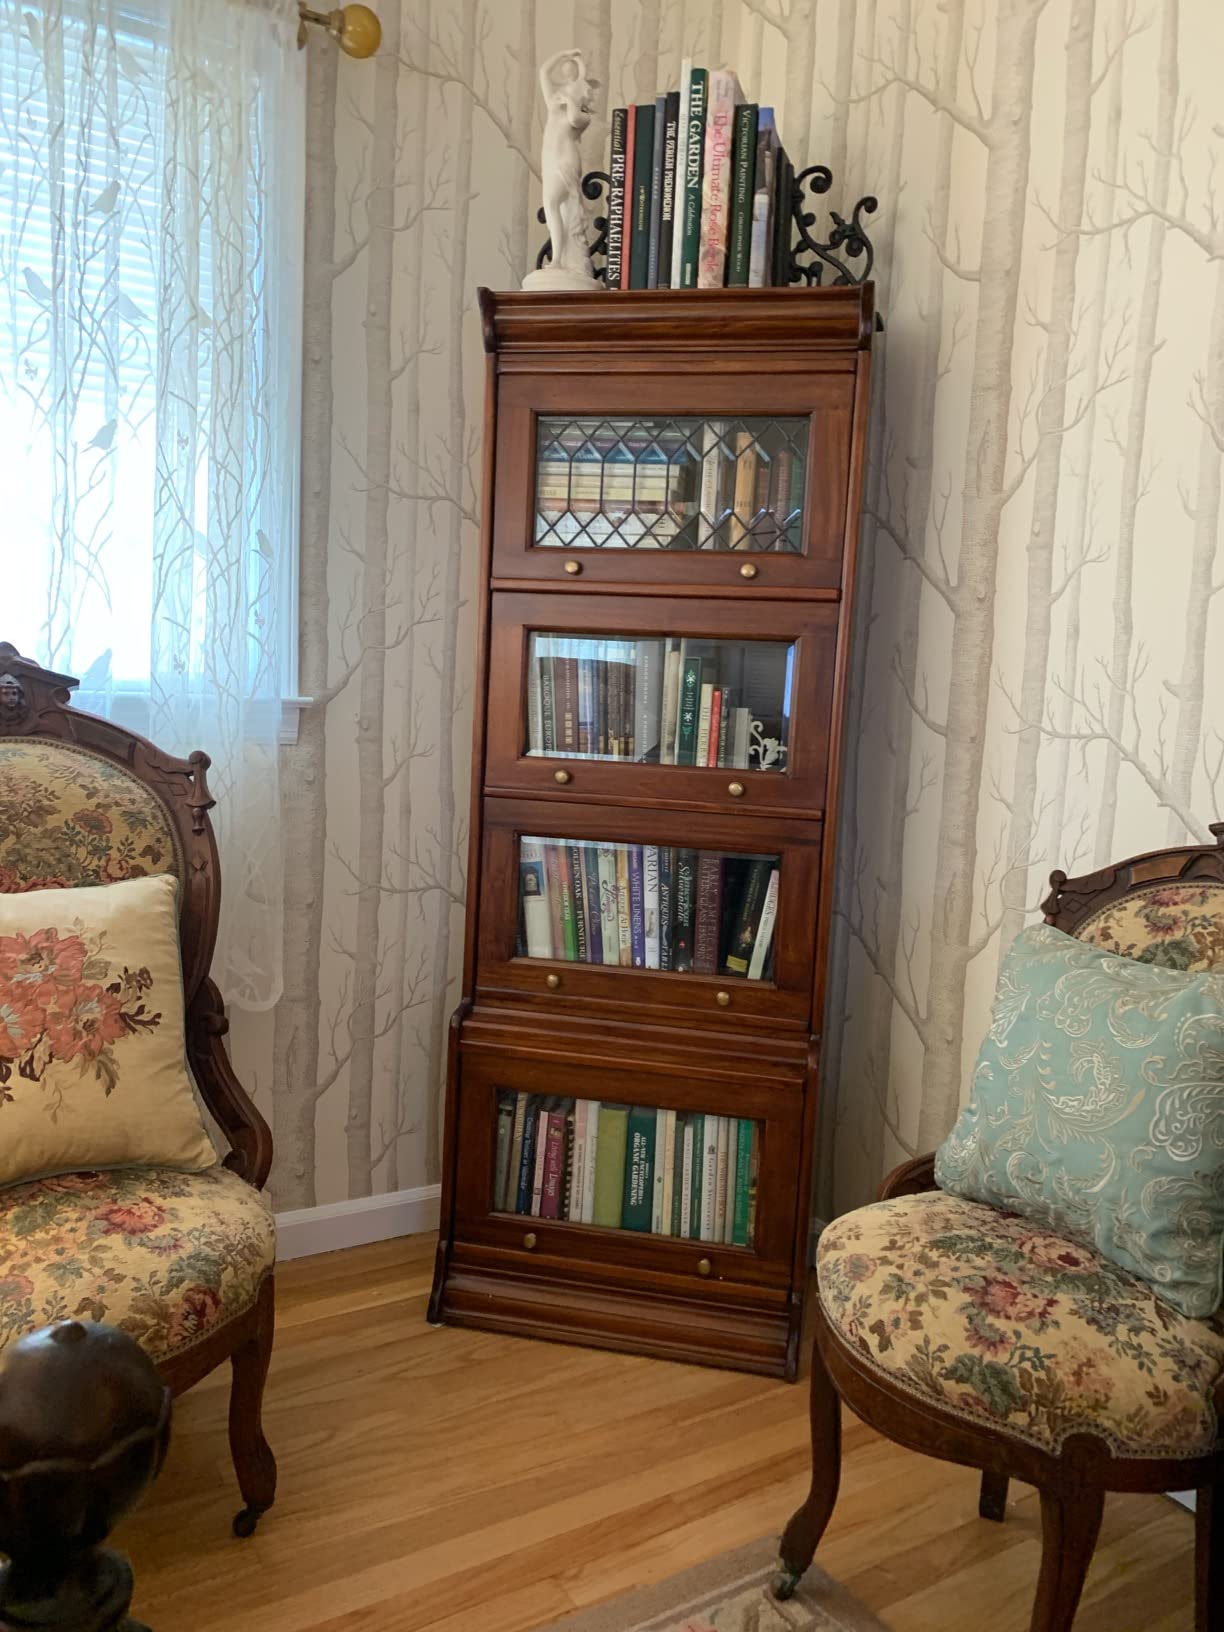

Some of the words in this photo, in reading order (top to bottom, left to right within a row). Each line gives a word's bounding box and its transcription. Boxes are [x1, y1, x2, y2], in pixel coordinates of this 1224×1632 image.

[690, 81, 704, 117] THE
[613, 111, 625, 151] Essential
[666, 121, 676, 138] THE
[713, 113, 729, 139] The
[740, 110, 752, 159] VICTORIAN
[664, 140, 675, 169] PARIAN
[687, 120, 701, 188] GARDEN
[710, 142, 727, 201] Ultimate
[662, 171, 673, 221] PHENOMENON
[737, 161, 749, 203] PAINTING
[608, 154, 625, 280] PRE-RAPHAELITES
[708, 204, 723, 235] Rose
[575, 880, 584, 899] OAK
[631, 872, 641, 903] WHITE
[677, 862, 692, 922] Silverplate
[701, 858, 712, 896] PATTERN
[709, 858, 720, 895] EARLY
[660, 883, 671, 926] ANTIQUES
[684, 872, 693, 928] American
[698, 897, 710, 923] GLASS
[633, 903, 643, 935] LINENS
[705, 903, 718, 961] AMERICAN
[550, 1140, 561, 1159] Living
[551, 1159, 559, 1172] with
[633, 1132, 641, 1163] ORGANIC
[640, 1136, 648, 1159] ALL-NEW
[630, 1164, 640, 1206] GARDENING
[638, 1160, 647, 1200] ENCYCLOPEDIA
[707, 1157, 715, 1187] Garden
